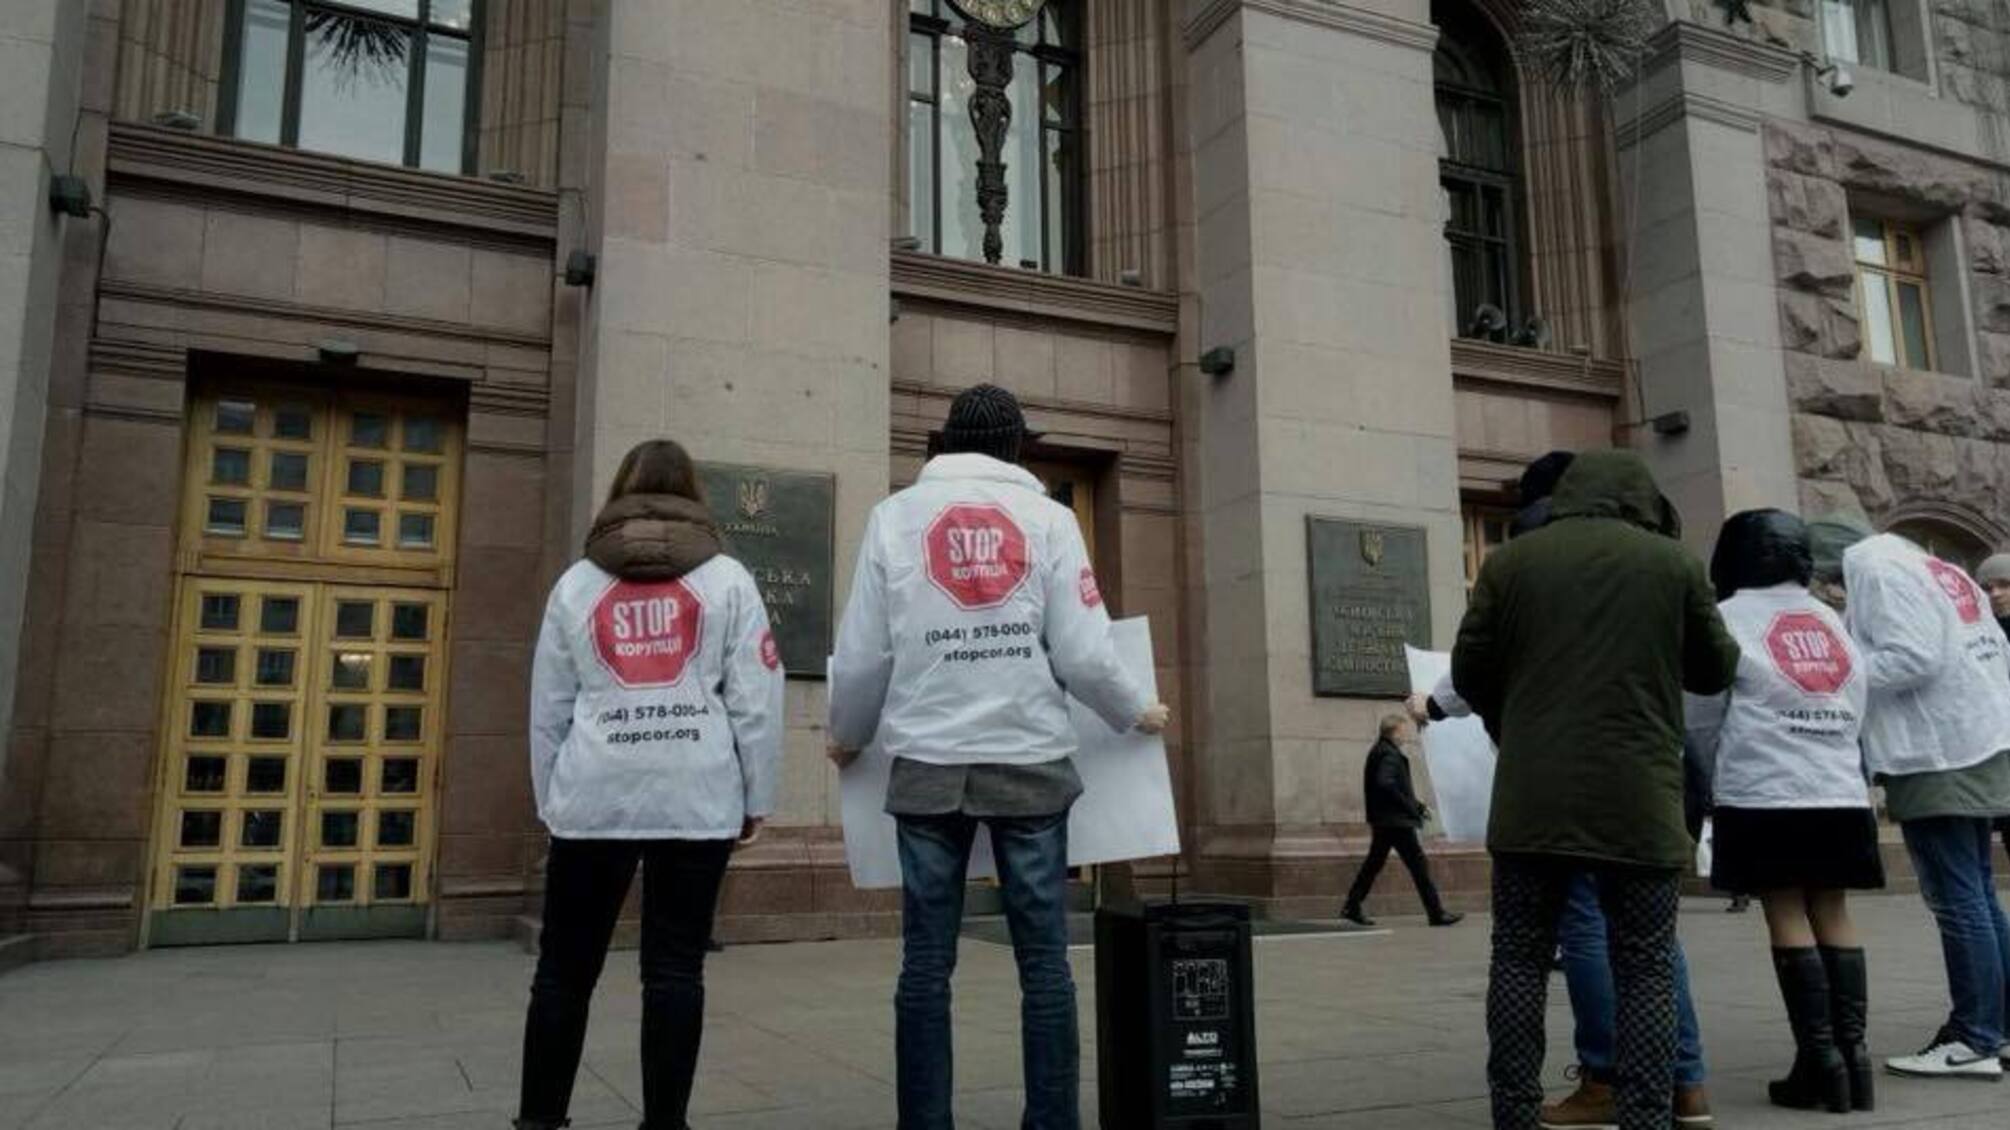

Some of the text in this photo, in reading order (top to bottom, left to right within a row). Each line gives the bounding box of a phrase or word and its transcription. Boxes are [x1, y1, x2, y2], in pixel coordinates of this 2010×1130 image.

[947, 527, 1003, 563] STOP
[613, 596, 680, 639] STOP
[925, 628, 967, 646] (044)
[1781, 630, 1831, 660] STOP
[607, 728, 700, 744] stopcor.org
